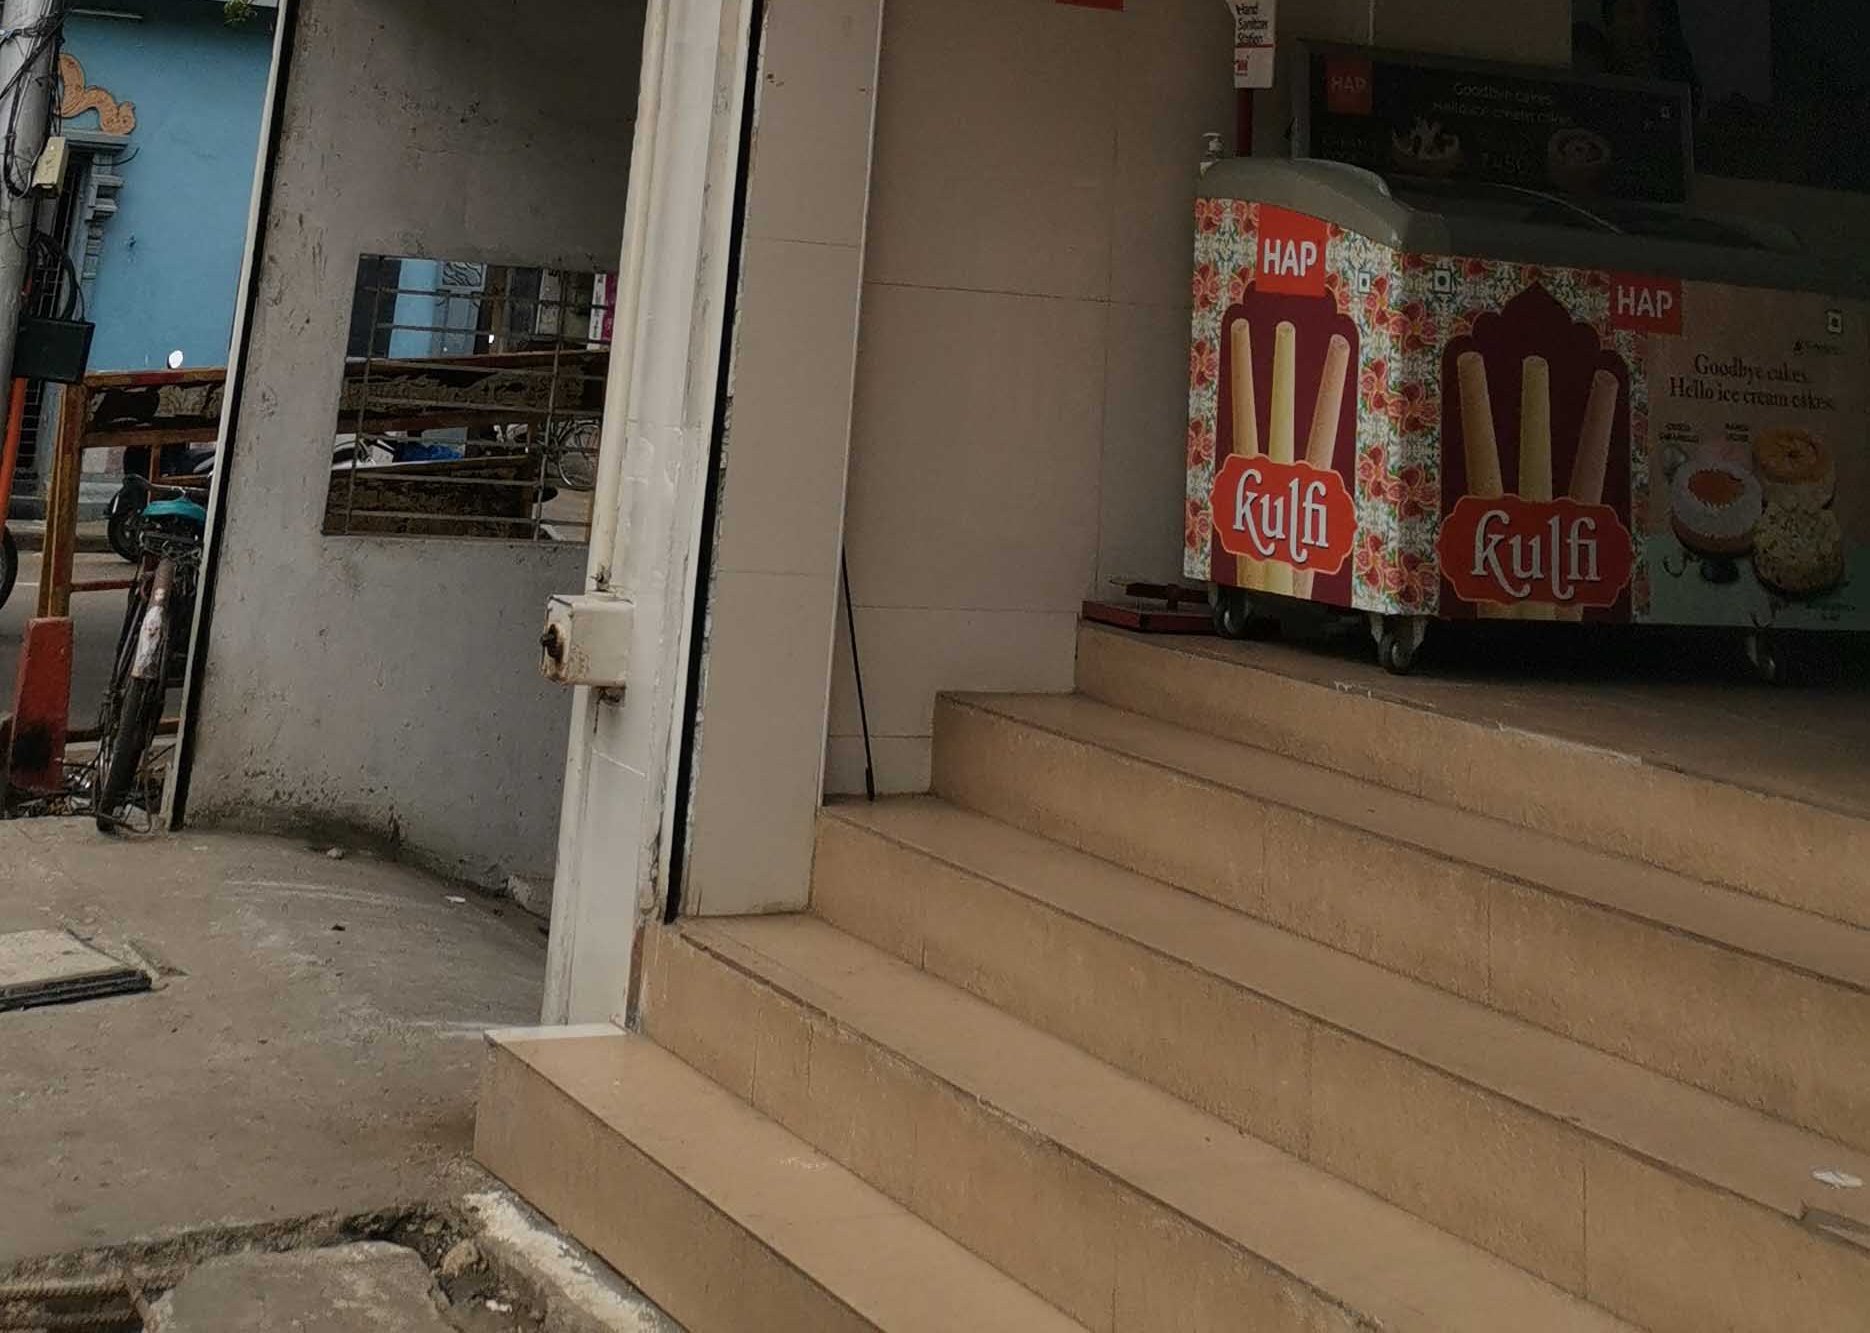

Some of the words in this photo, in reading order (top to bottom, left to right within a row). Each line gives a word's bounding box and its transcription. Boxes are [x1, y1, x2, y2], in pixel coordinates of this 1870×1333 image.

[1329, 76, 1368, 93] HAP
[1263, 238, 1317, 277] HAP
[1617, 285, 1673, 318] HAP
[1694, 354, 1761, 385] Goodbye
[1669, 377, 1714, 400] Hello
[1719, 382, 1739, 402] ice
[1744, 390, 1787, 406] cream
